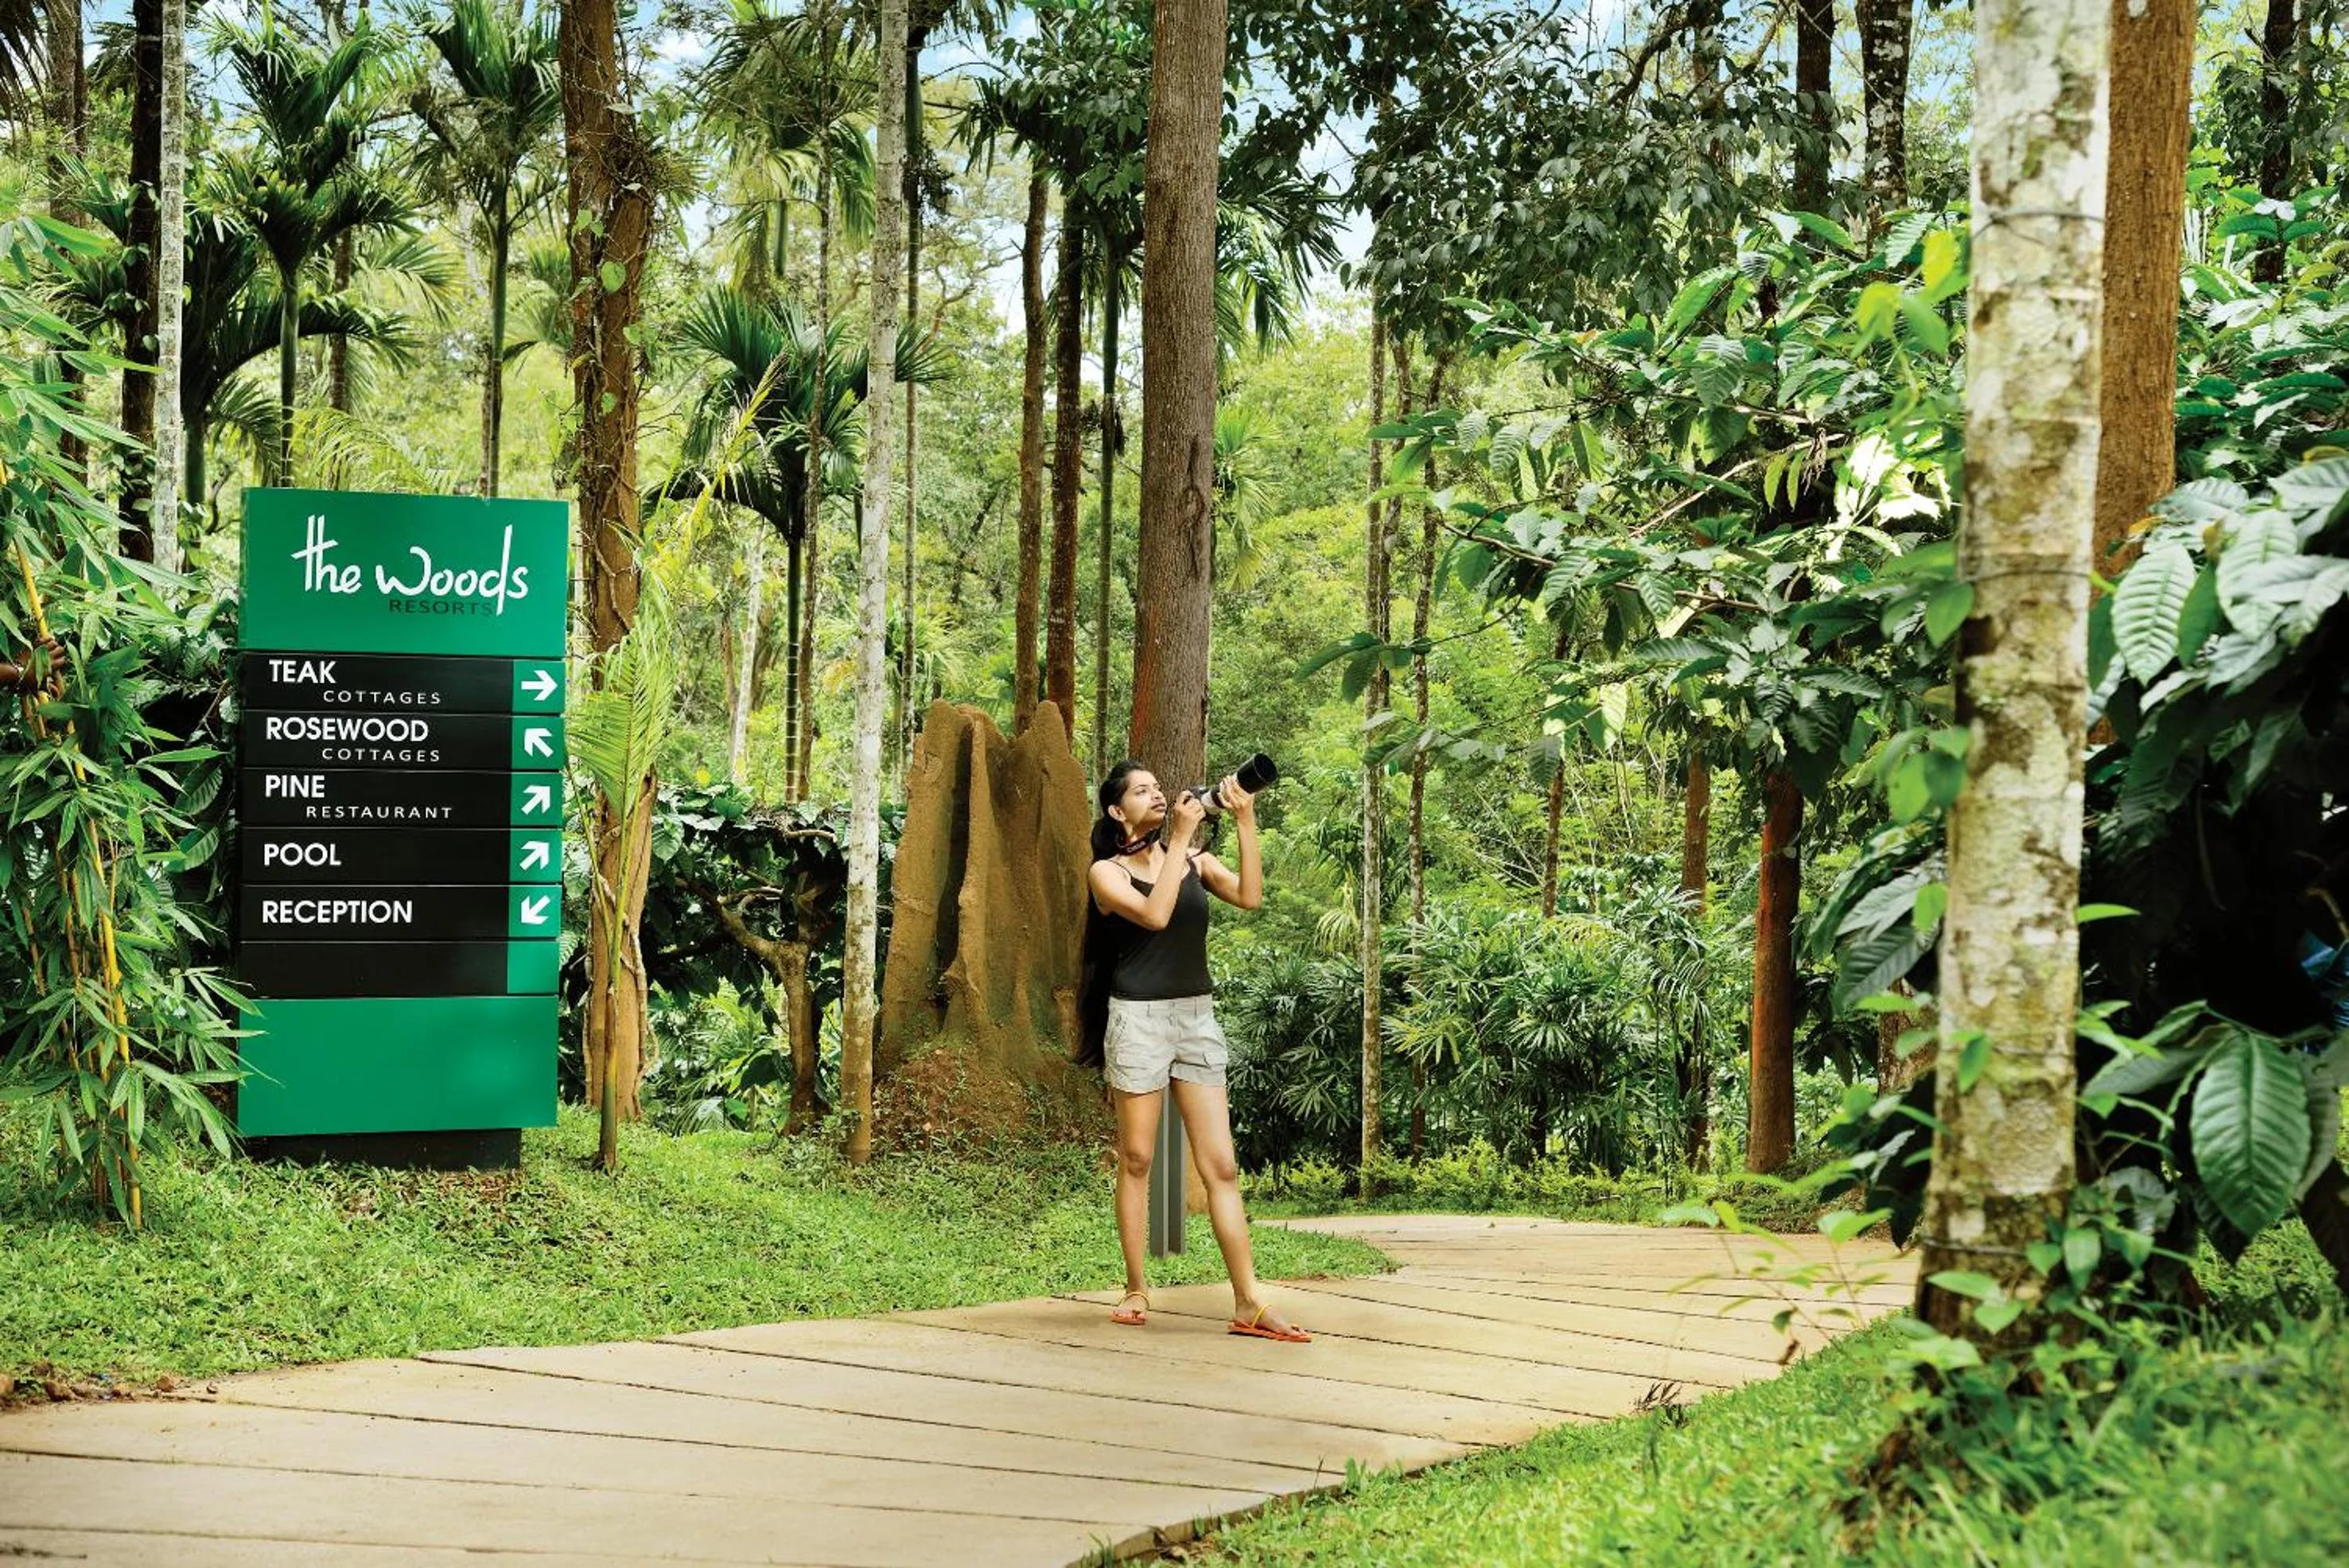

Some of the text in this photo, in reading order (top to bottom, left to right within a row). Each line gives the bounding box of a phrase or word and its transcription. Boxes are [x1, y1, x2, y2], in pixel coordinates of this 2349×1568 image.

[291, 515, 363, 594] the
[389, 598, 493, 617] RESORTS
[269, 659, 337, 684] TEAK
[323, 690, 441, 705] COTTAGES
[266, 717, 429, 741] ROSEWOOD
[321, 748, 440, 762] COTTAGES
[265, 774, 325, 798] PINE
[305, 805, 453, 819] RESTAURANT
[264, 842, 342, 866] POOL
[262, 900, 413, 924] RECEPTION
